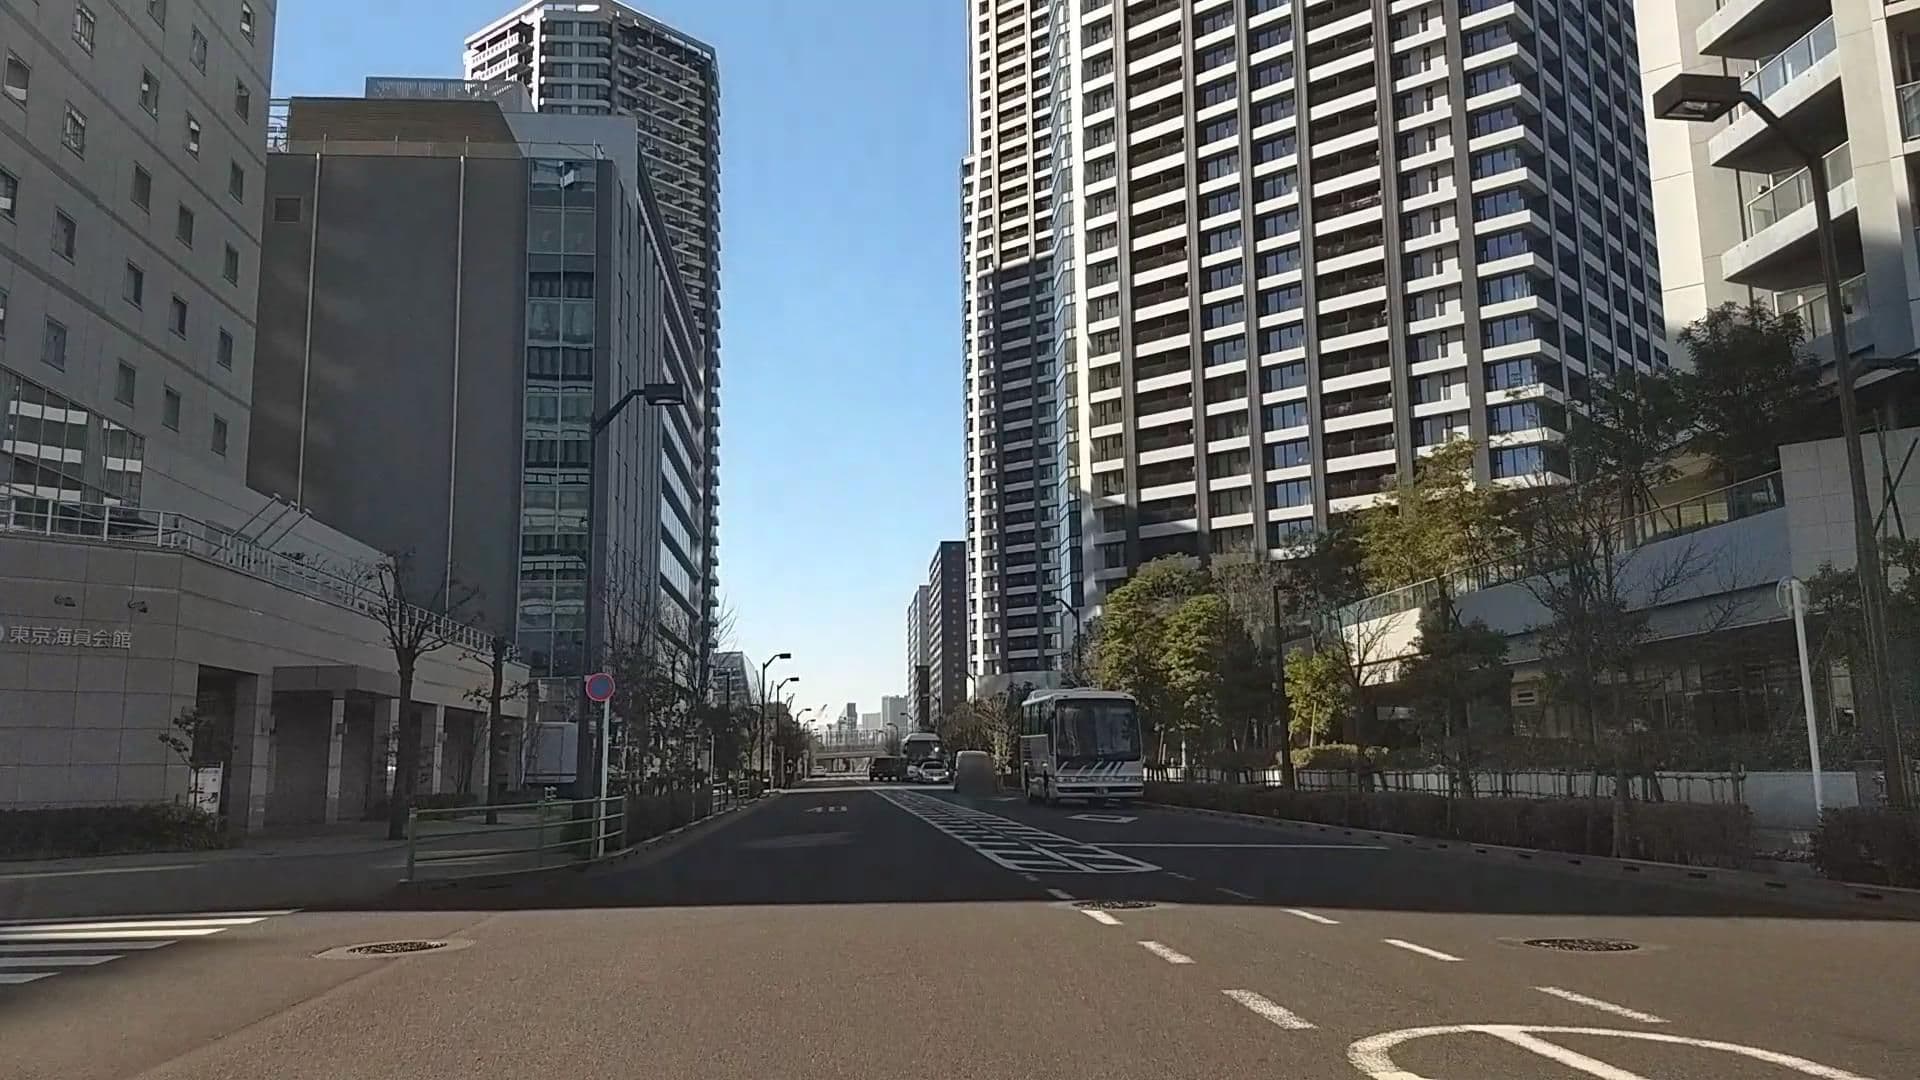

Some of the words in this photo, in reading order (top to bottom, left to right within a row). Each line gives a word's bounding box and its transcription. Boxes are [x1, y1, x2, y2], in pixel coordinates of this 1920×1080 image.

[9, 625, 131, 648] 東京海員会館
